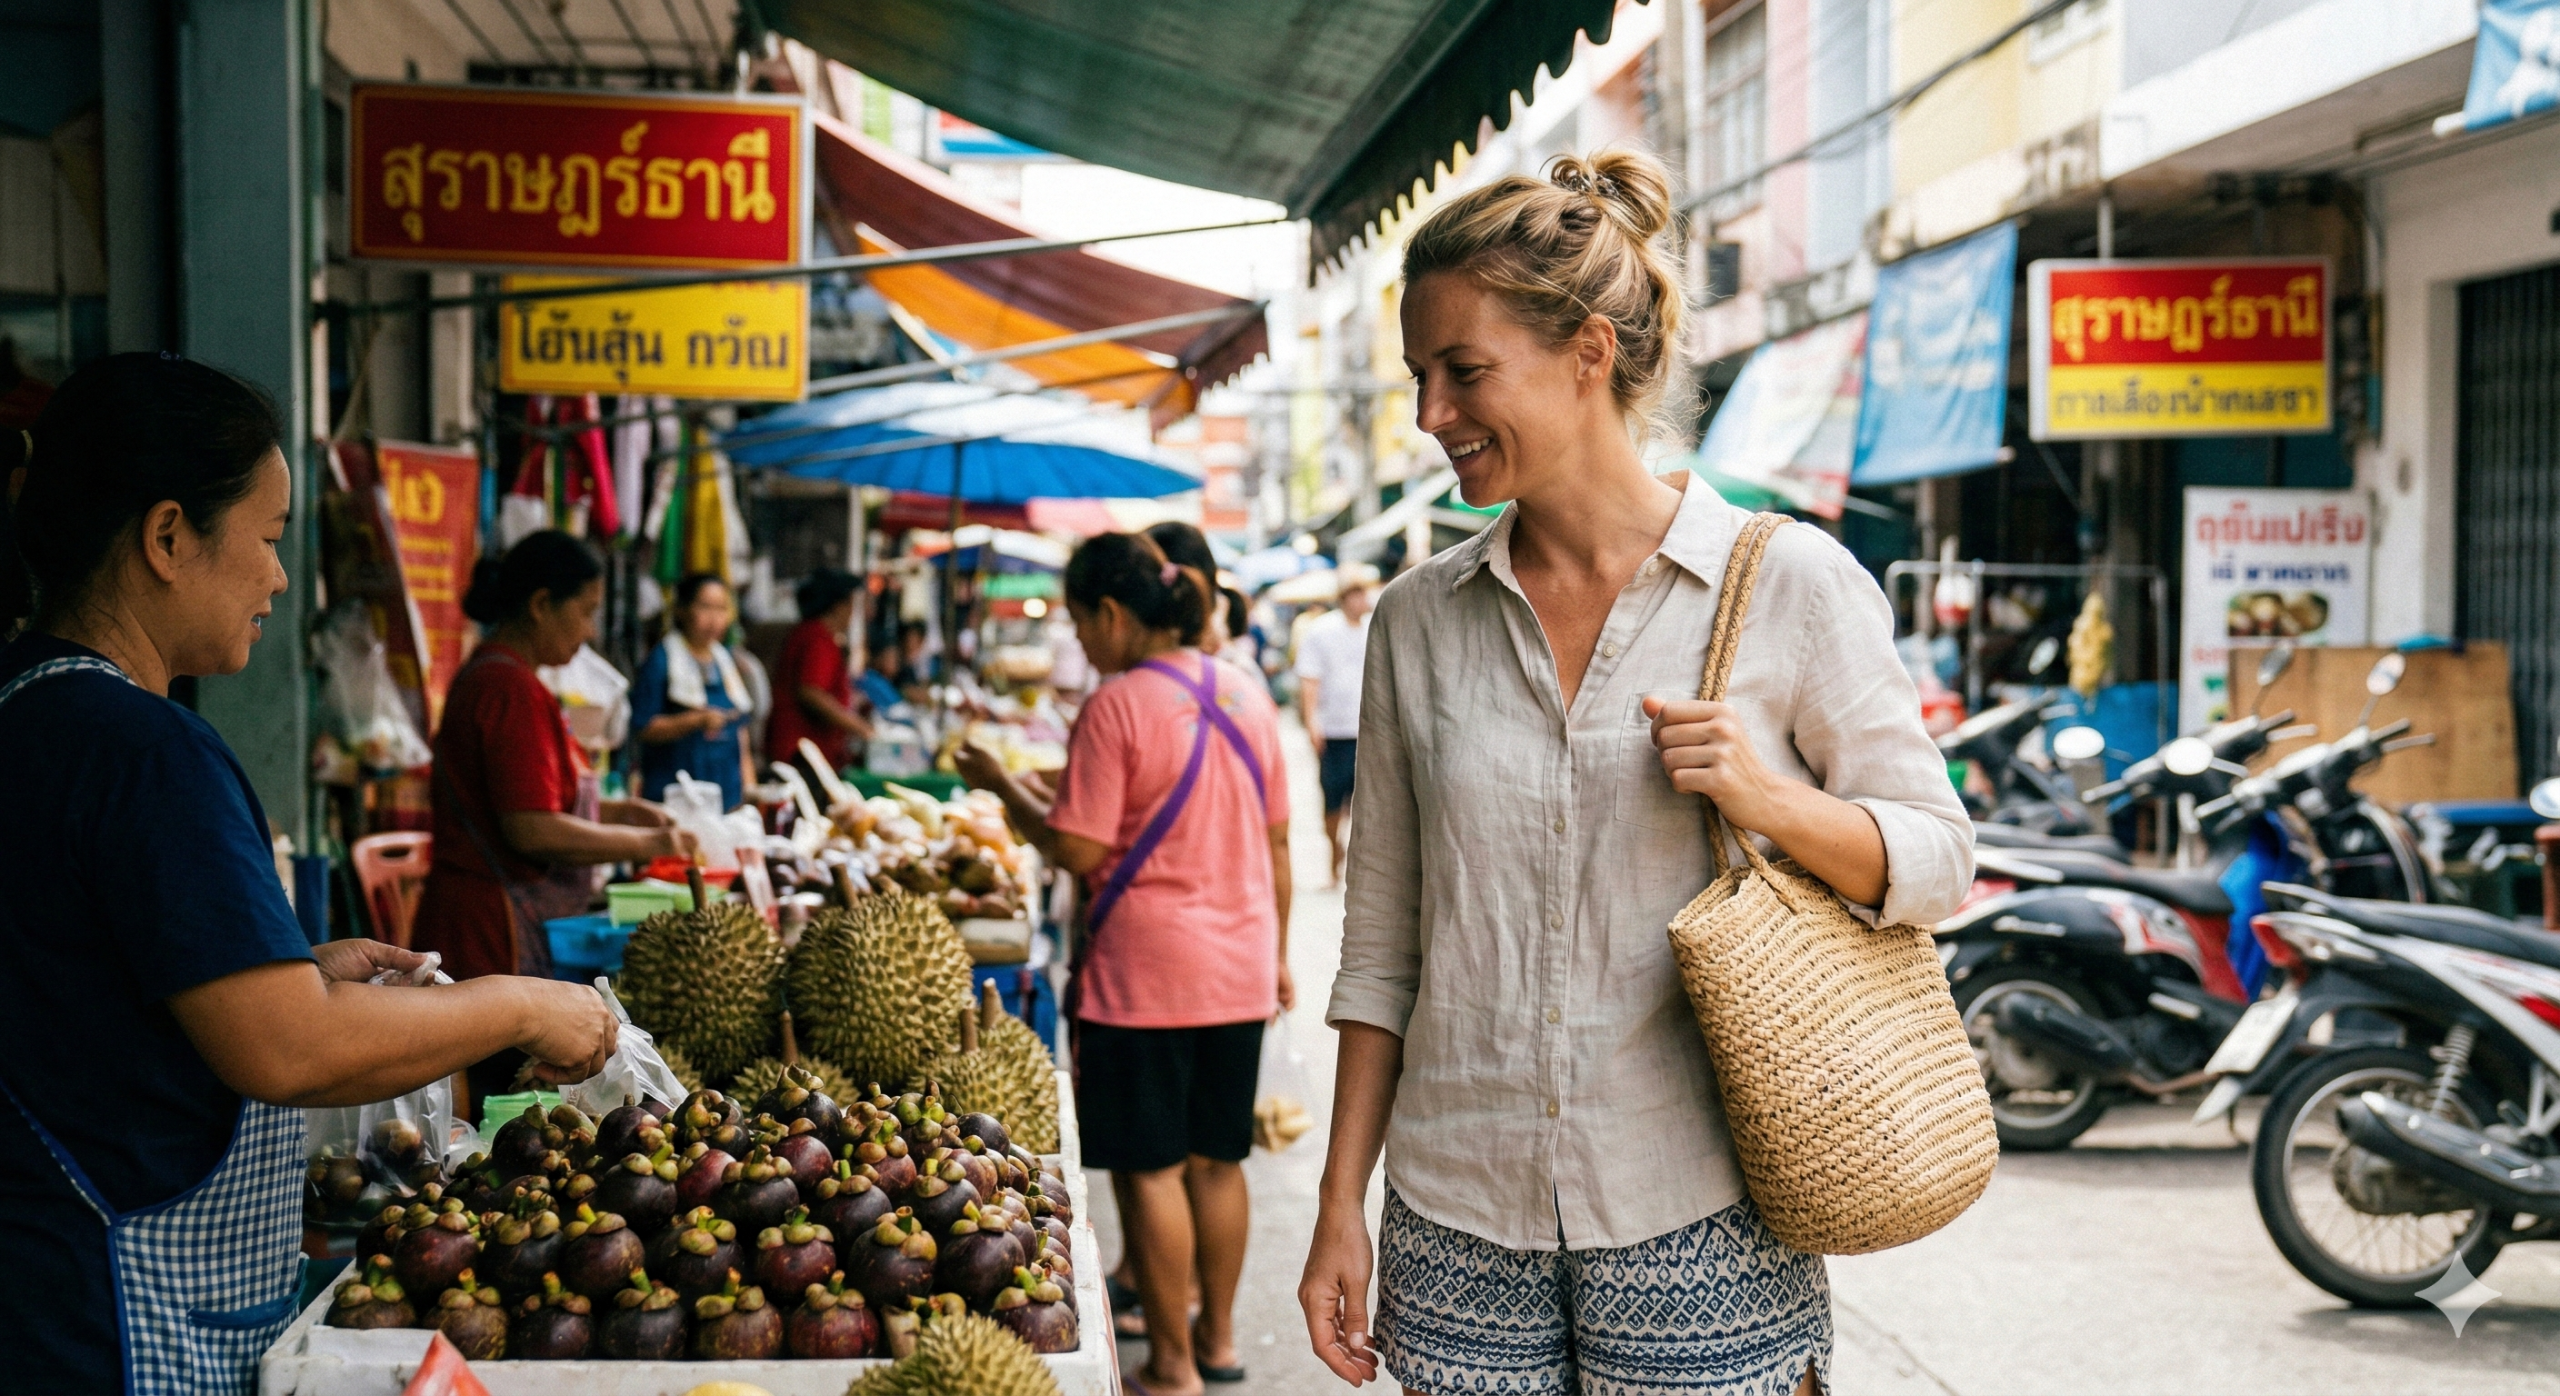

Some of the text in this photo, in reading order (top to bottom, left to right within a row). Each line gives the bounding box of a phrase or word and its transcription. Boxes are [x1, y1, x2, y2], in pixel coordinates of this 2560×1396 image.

[383, 120, 777, 242] สุราษฎร์ธานี
[2052, 273, 2321, 362] สุราษฎร์ธานี
